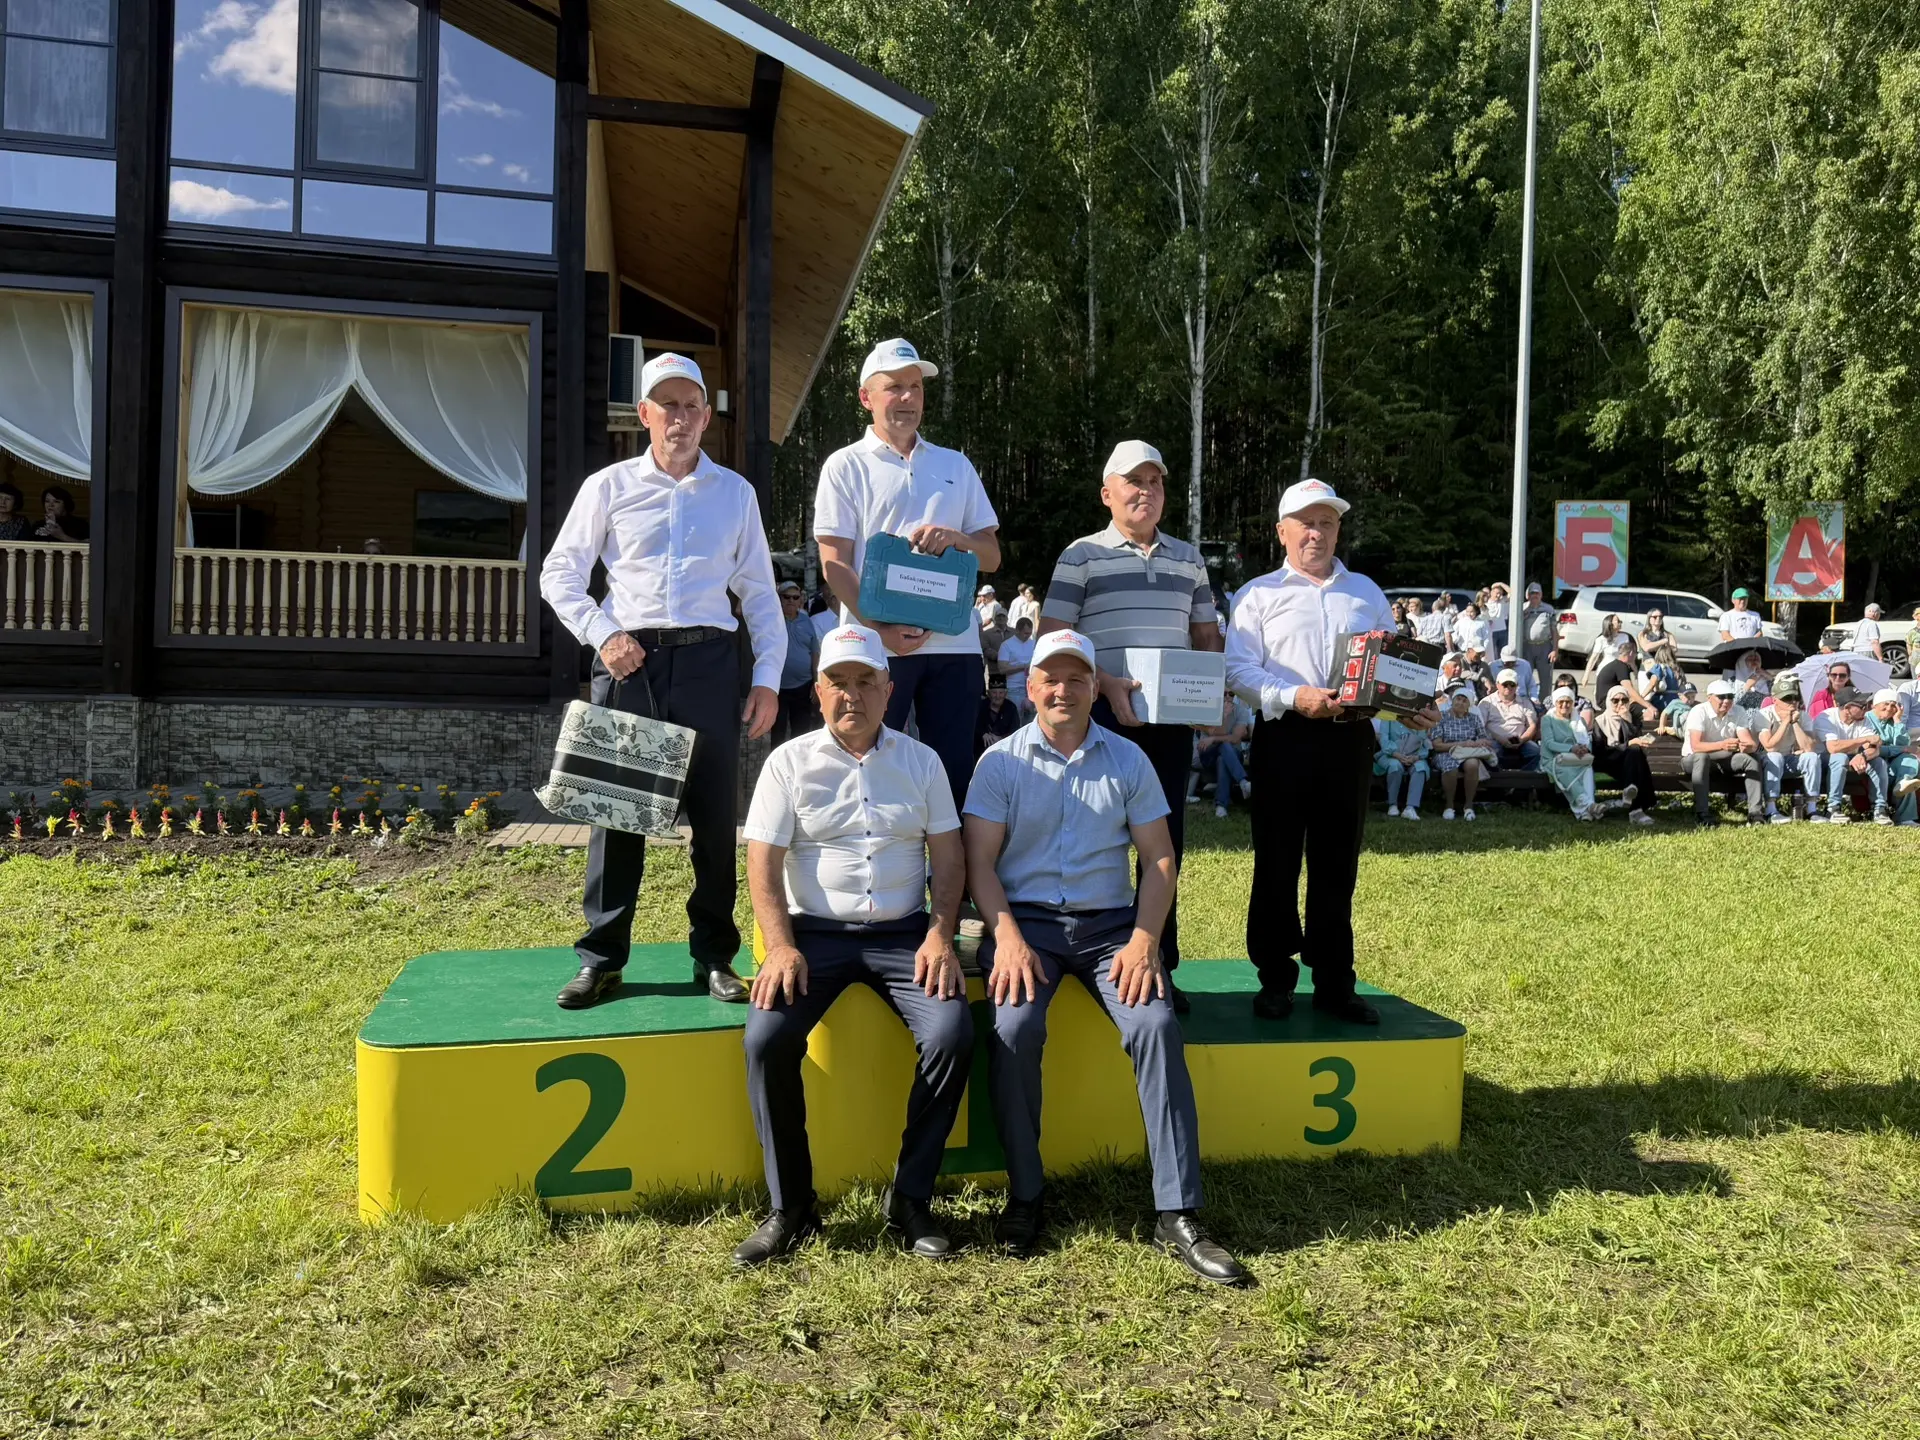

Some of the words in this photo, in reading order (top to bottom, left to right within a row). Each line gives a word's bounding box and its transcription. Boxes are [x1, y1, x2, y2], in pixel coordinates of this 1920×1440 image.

[1566, 517, 1617, 586] Б
[1773, 517, 1838, 585] А
[535, 1052, 633, 1198] 2
[1303, 1056, 1357, 1146] 3
